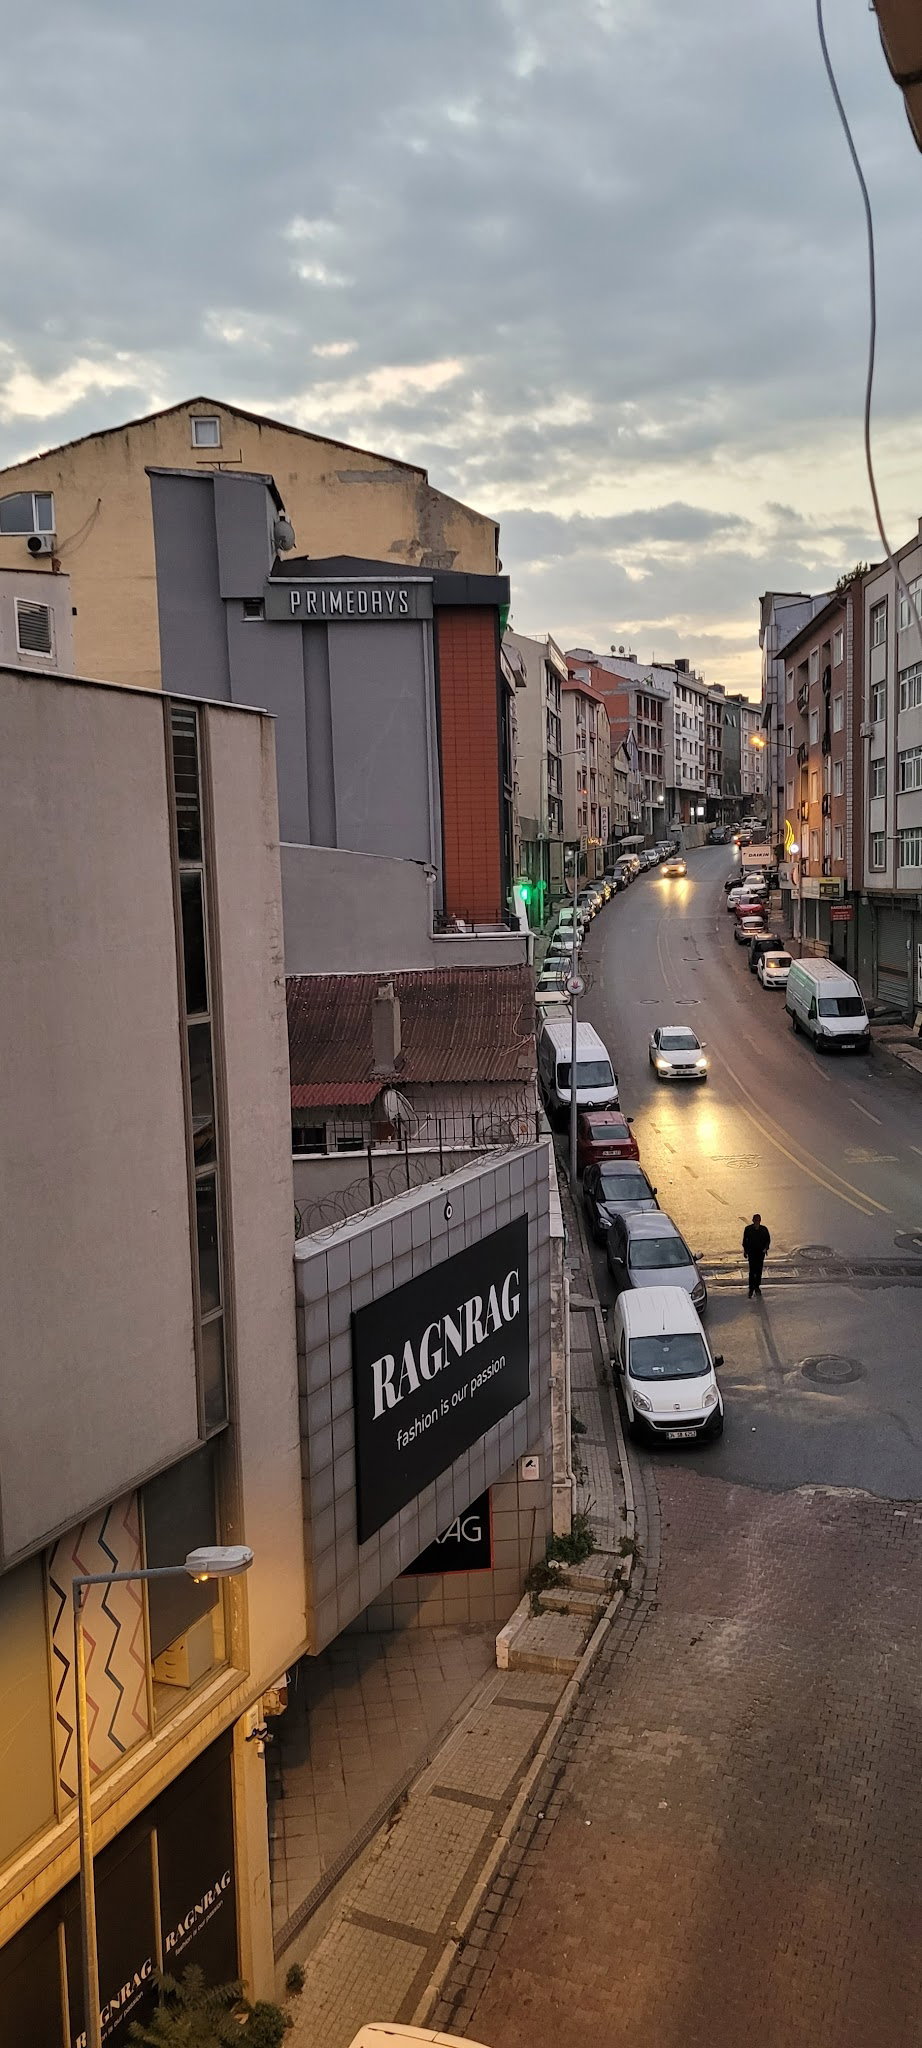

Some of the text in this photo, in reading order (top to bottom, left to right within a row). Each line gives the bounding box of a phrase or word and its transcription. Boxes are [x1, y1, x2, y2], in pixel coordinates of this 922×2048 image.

[290, 590, 409, 614] PRIMEDAYS
[371, 1267, 521, 1421] RAGNRAG
[396, 1355, 506, 1451] fashion is our passion
[435, 1516, 482, 1544] AG
[165, 1870, 231, 1954] RAGNRAG
[76, 1957, 152, 2048] RGNRAG
